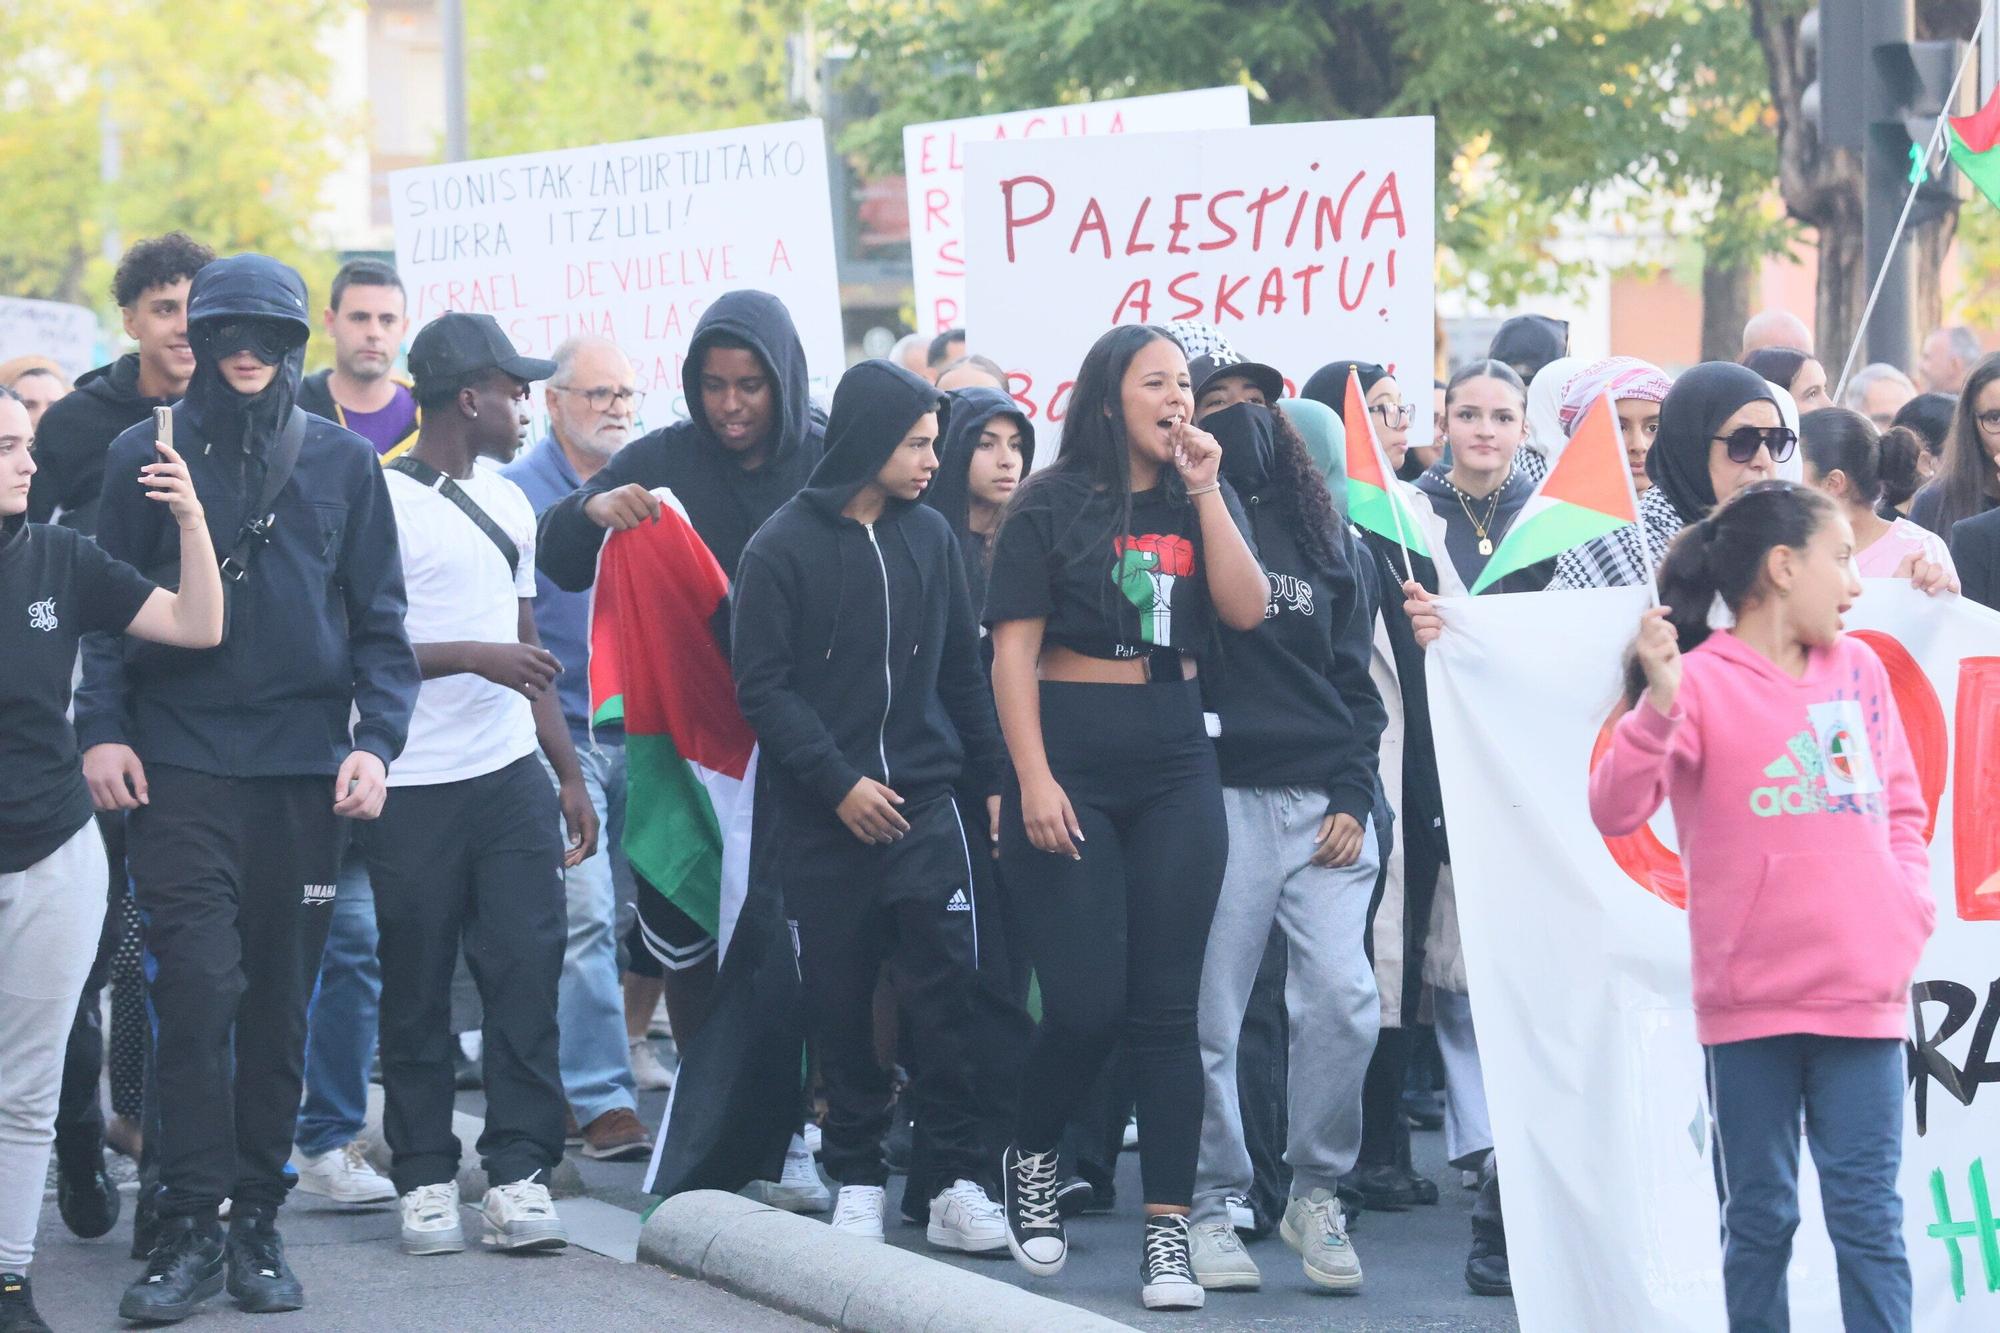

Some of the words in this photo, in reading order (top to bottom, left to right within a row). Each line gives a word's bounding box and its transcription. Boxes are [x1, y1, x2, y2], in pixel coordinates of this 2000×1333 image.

[412, 222, 512, 264] LURRA
[549, 193, 693, 245] ITZULI!
[418, 274, 528, 320] ISRAEL
[566, 245, 738, 300] DEVUELVE
[769, 238, 793, 276] A
[1111, 250, 1397, 325] ASKATU!
